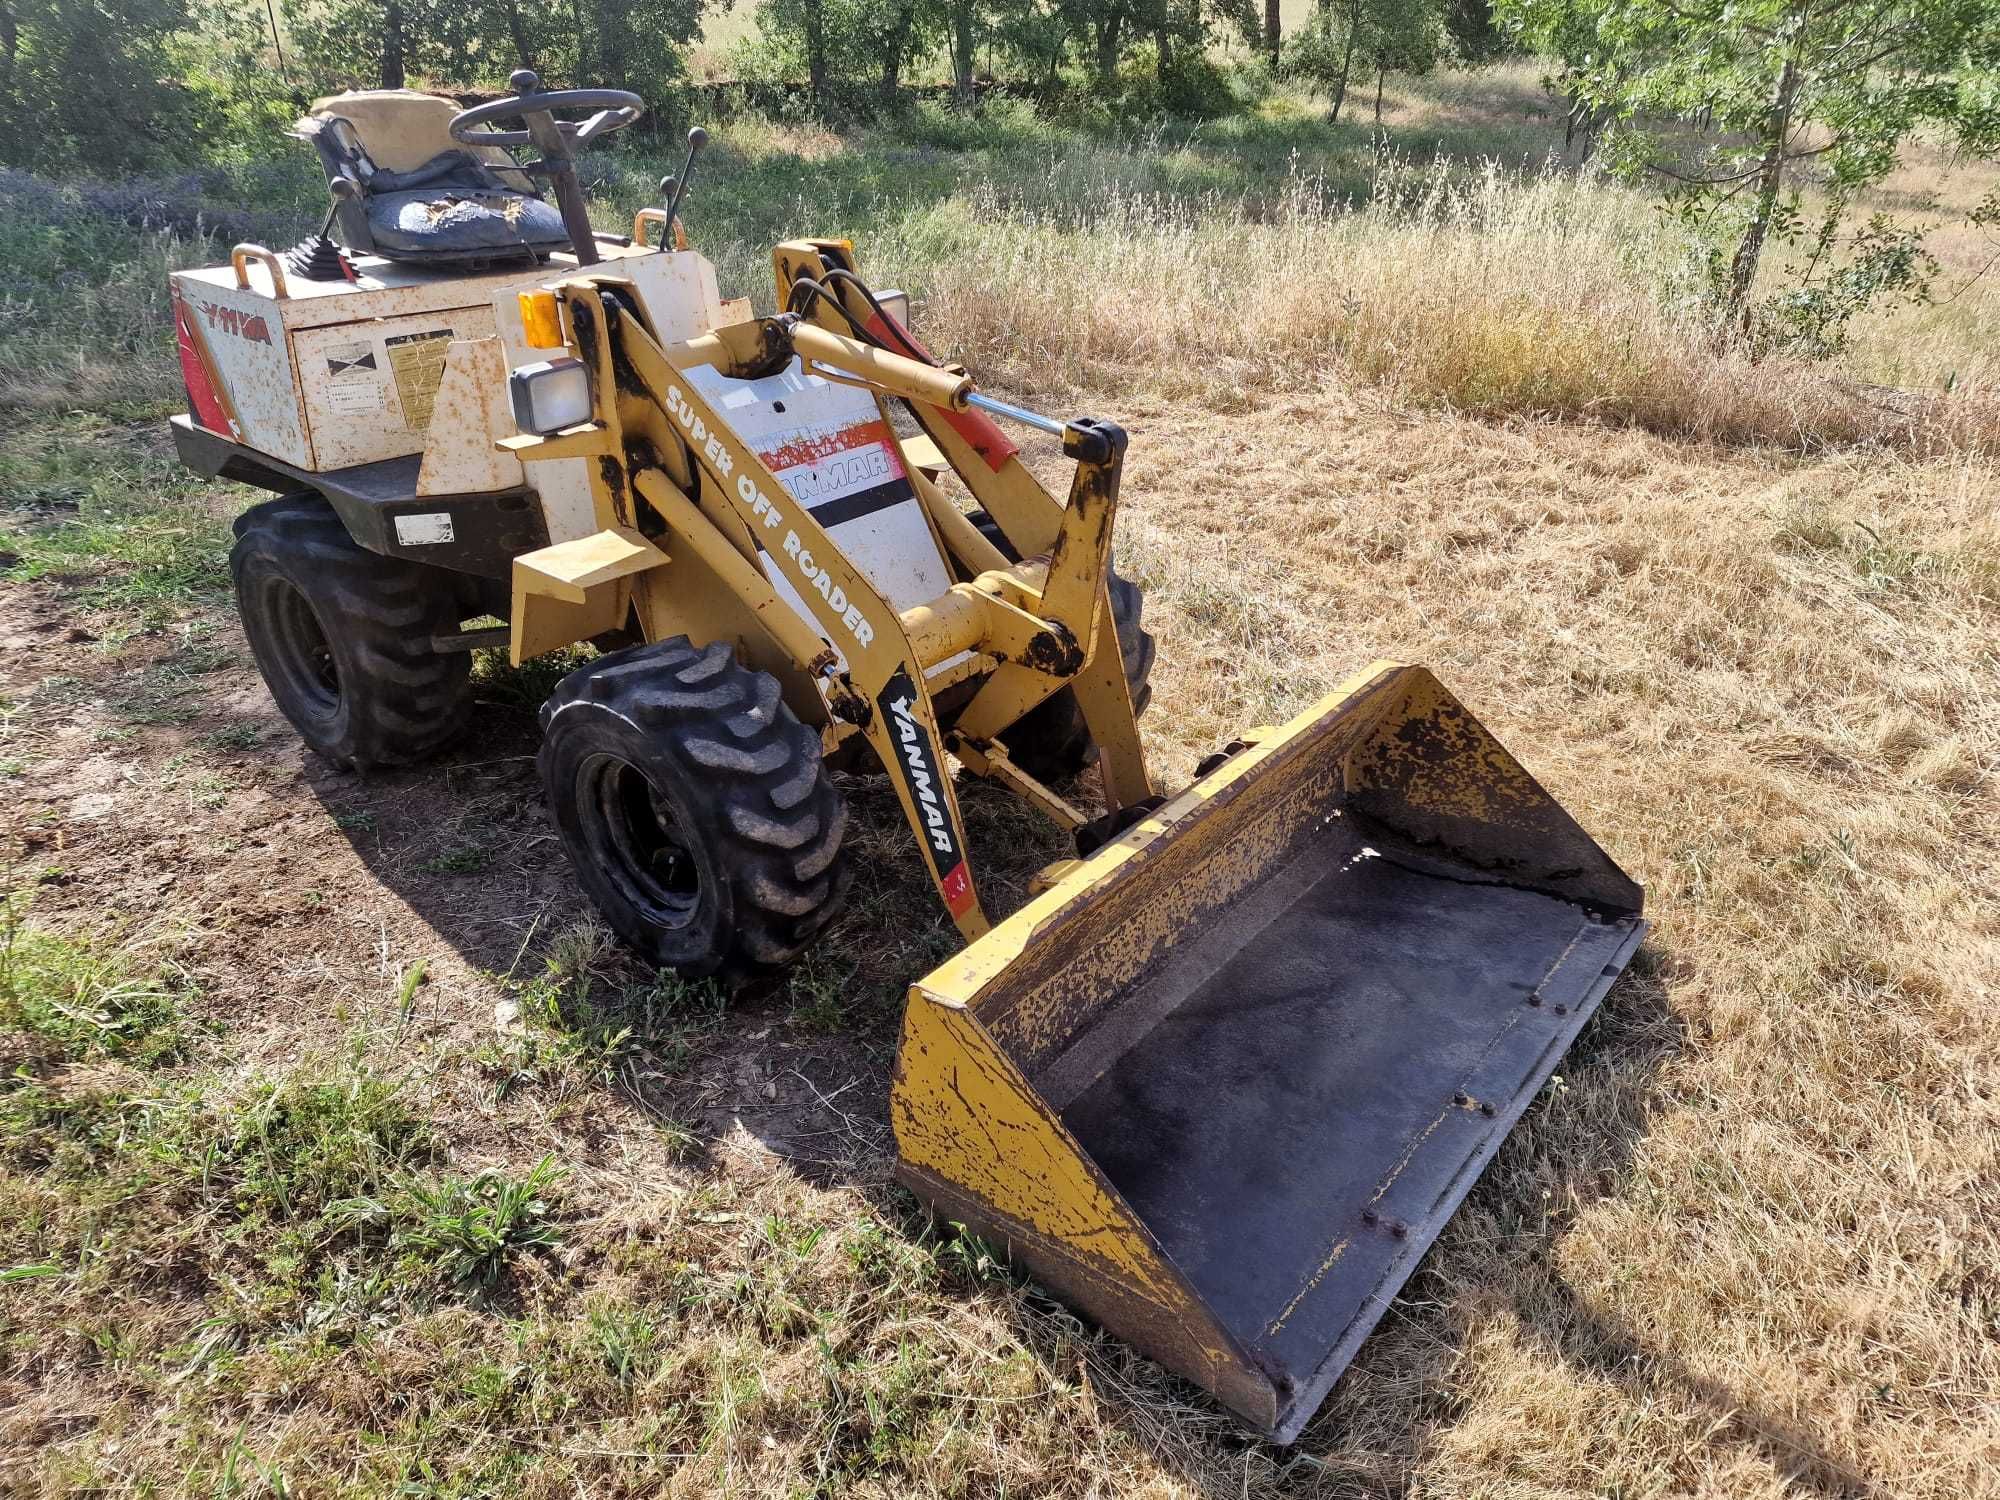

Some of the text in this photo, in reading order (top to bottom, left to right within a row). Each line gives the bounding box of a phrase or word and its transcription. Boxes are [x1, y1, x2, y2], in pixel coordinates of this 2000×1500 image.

[665, 384, 875, 648] SUPER OFF ROADER
[889, 695, 953, 854] YANMAR
